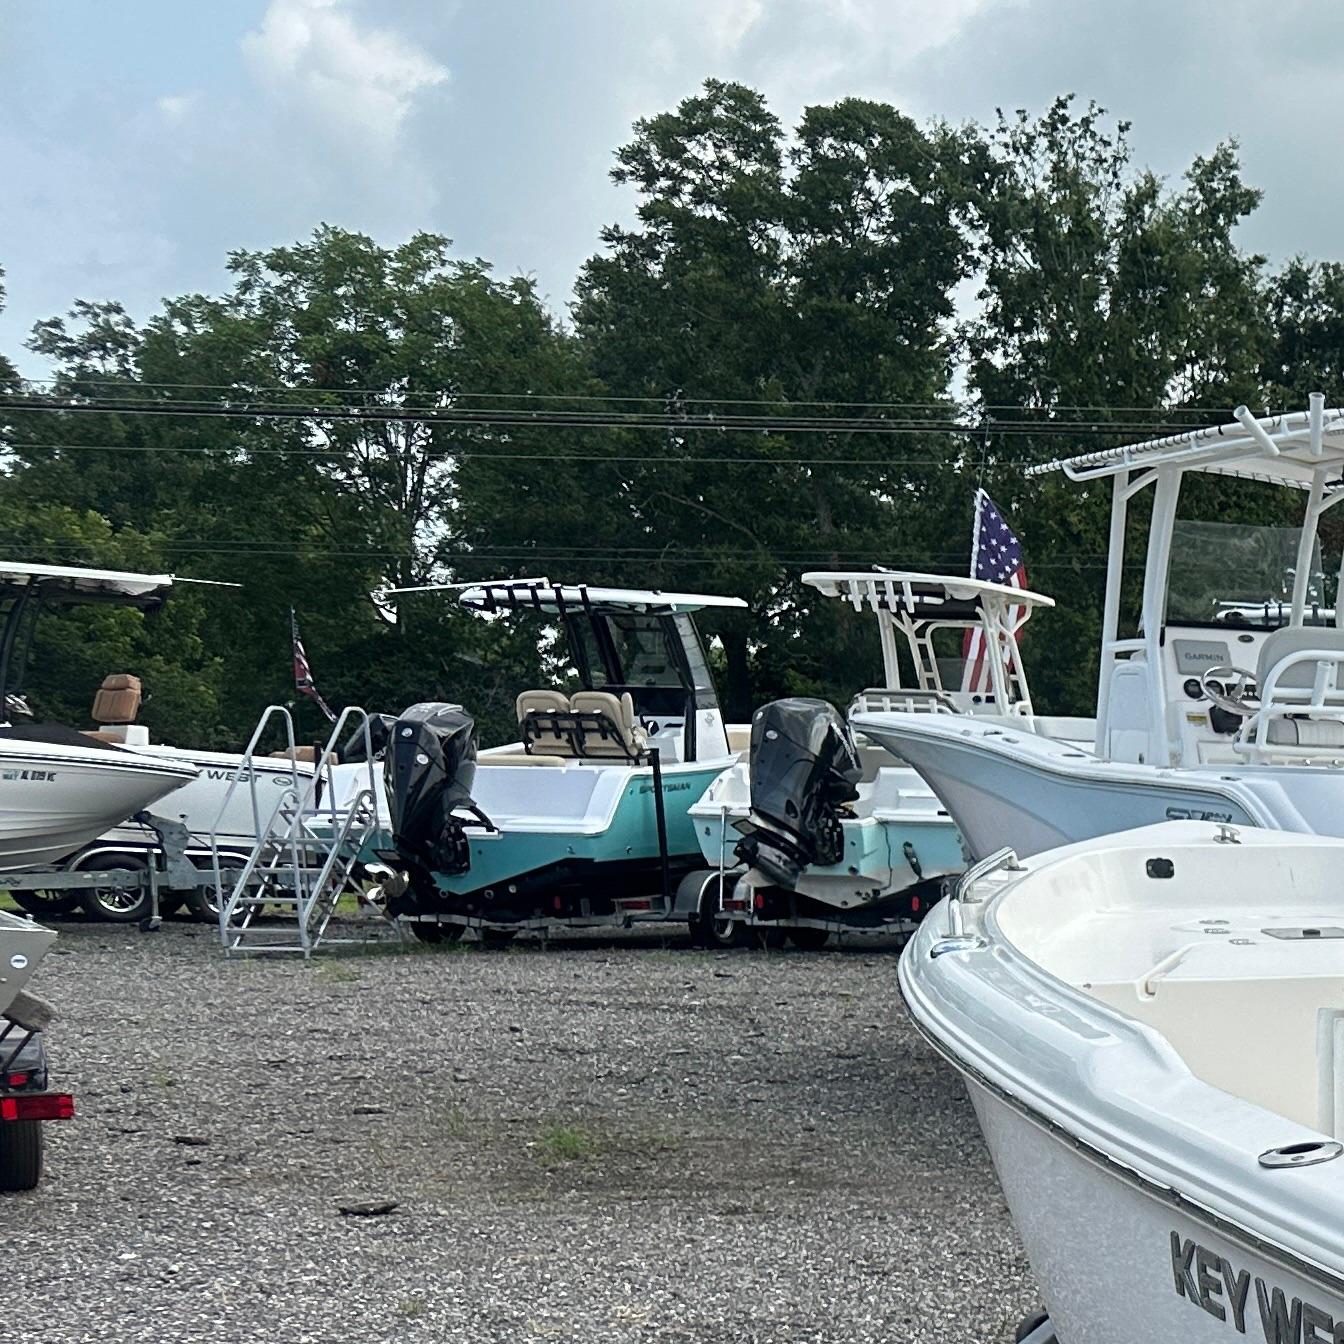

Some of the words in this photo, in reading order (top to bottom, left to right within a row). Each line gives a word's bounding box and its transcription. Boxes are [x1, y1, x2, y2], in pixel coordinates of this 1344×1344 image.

[1184, 652, 1224, 662] GARMIN
[639, 782, 691, 793] SPOTSMAN
[1170, 1230, 1251, 1334] KEY
